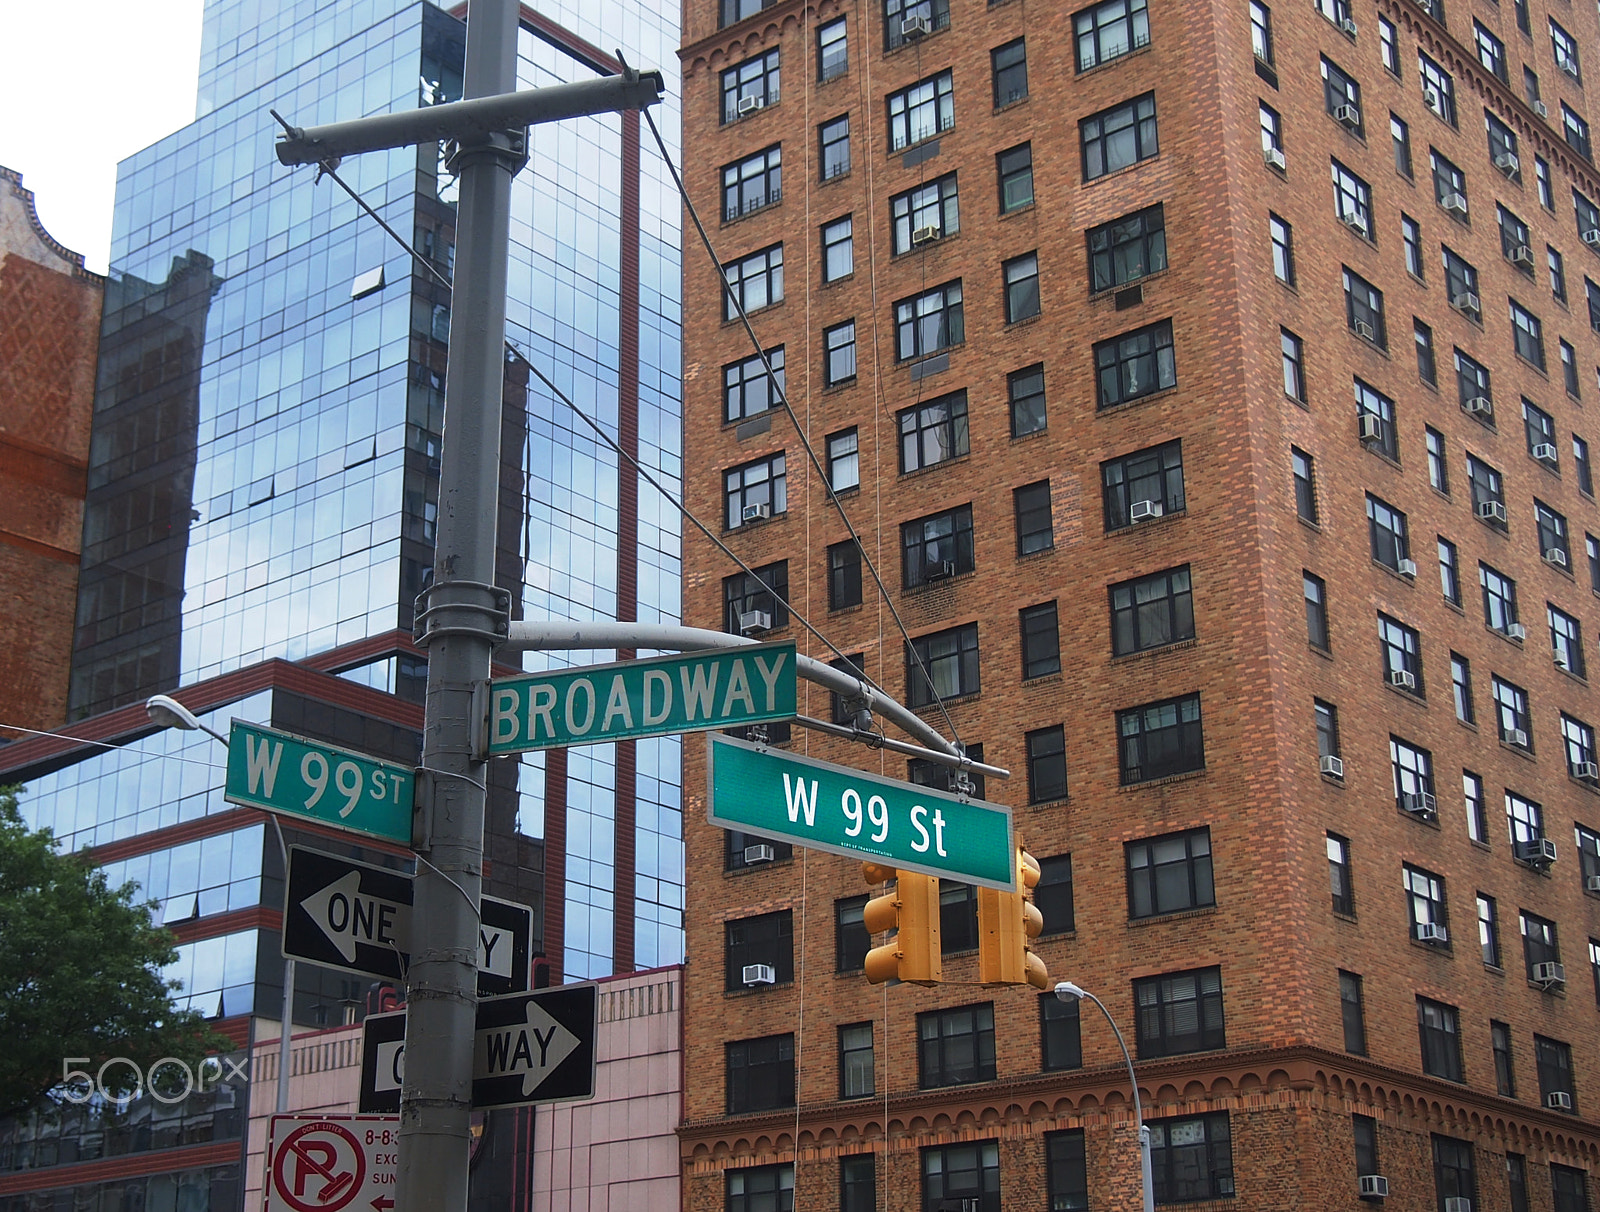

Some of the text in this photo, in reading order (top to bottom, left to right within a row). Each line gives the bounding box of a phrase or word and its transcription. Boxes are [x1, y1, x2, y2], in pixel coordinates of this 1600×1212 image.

[491, 653, 788, 745] BROADWAY
[246, 734, 405, 819] W 99 ST
[782, 773, 947, 857] W 99 St
[328, 892, 397, 943] ONE
[487, 1025, 557, 1073] WAY
[322, 1123, 343, 1134] LITTER
